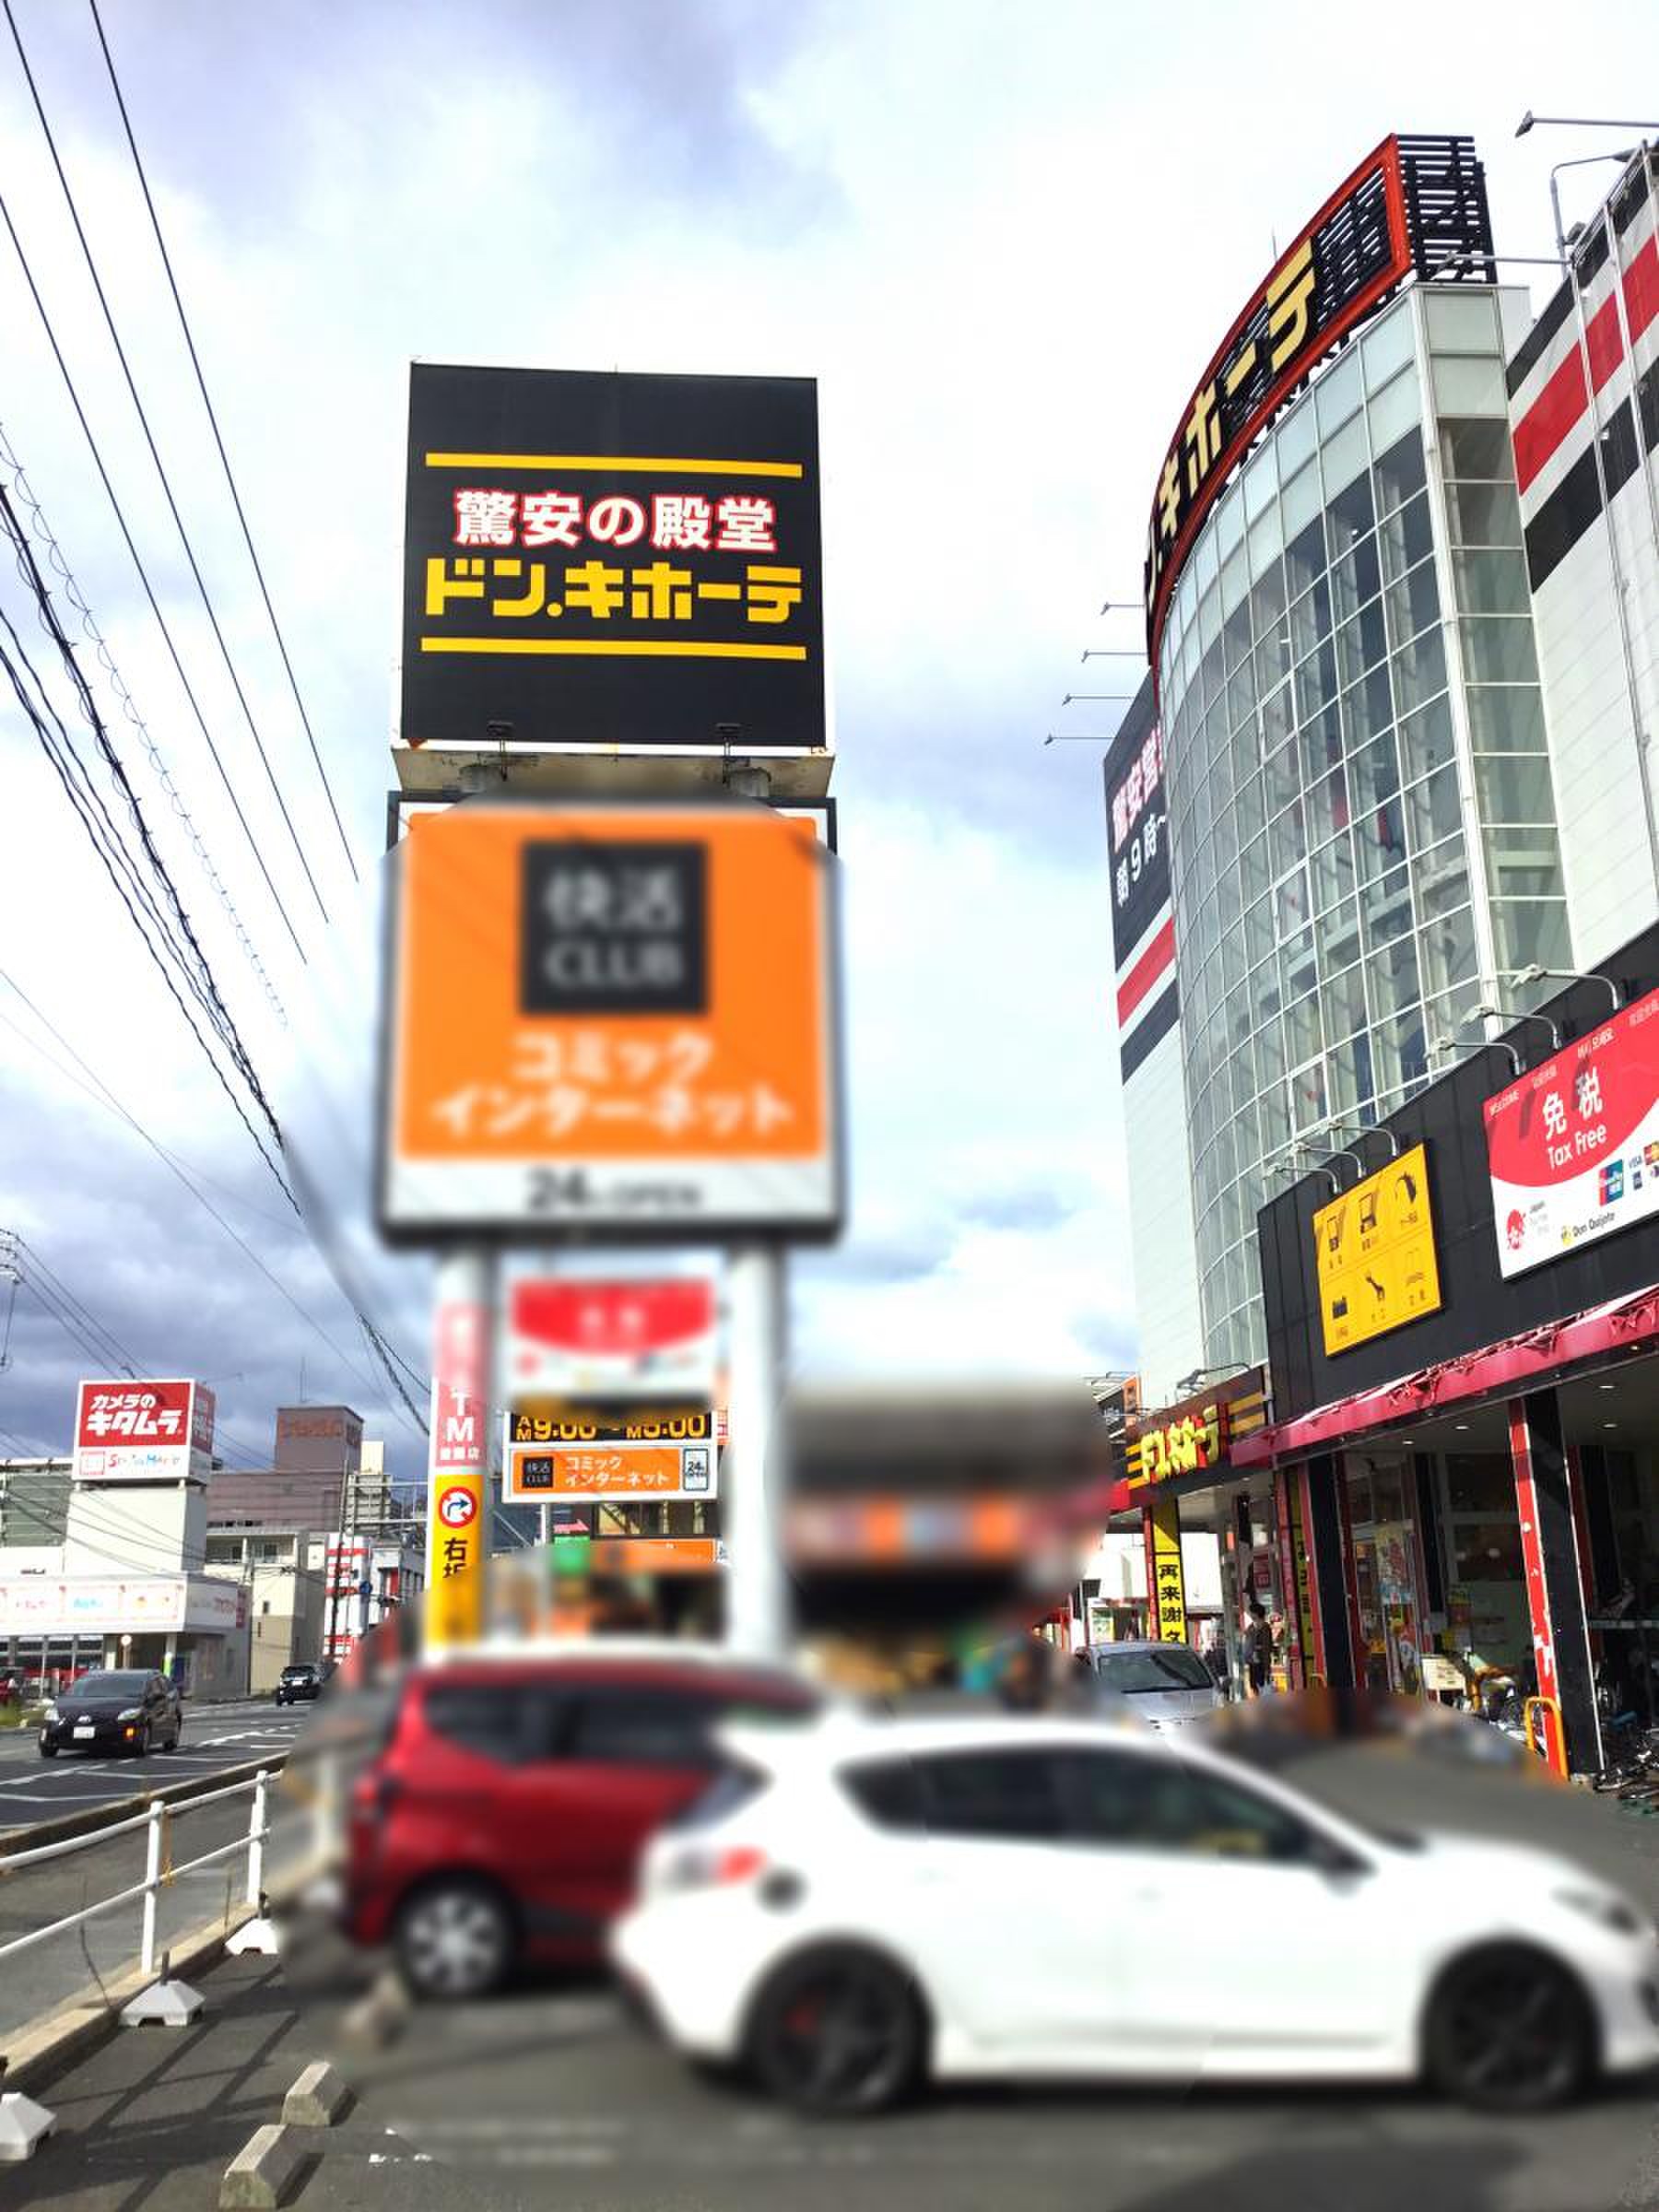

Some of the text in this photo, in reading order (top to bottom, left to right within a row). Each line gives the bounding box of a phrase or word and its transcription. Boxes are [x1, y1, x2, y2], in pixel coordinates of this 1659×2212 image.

[453, 488, 777, 551] 驚安の殿堂
[426, 558, 803, 623] ドン.キホーテ
[512, 1031, 713, 1083] コミック
[433, 1080, 794, 1137] インターネット
[1542, 1065, 1604, 1141] 免税
[1547, 1124, 1607, 1171] Tax Free
[86, 1409, 182, 1437] キタムラ
[89, 1393, 157, 1410] カメラの
[563, 1471, 670, 1487] インターネット
[565, 1455, 623, 1472] コミック
